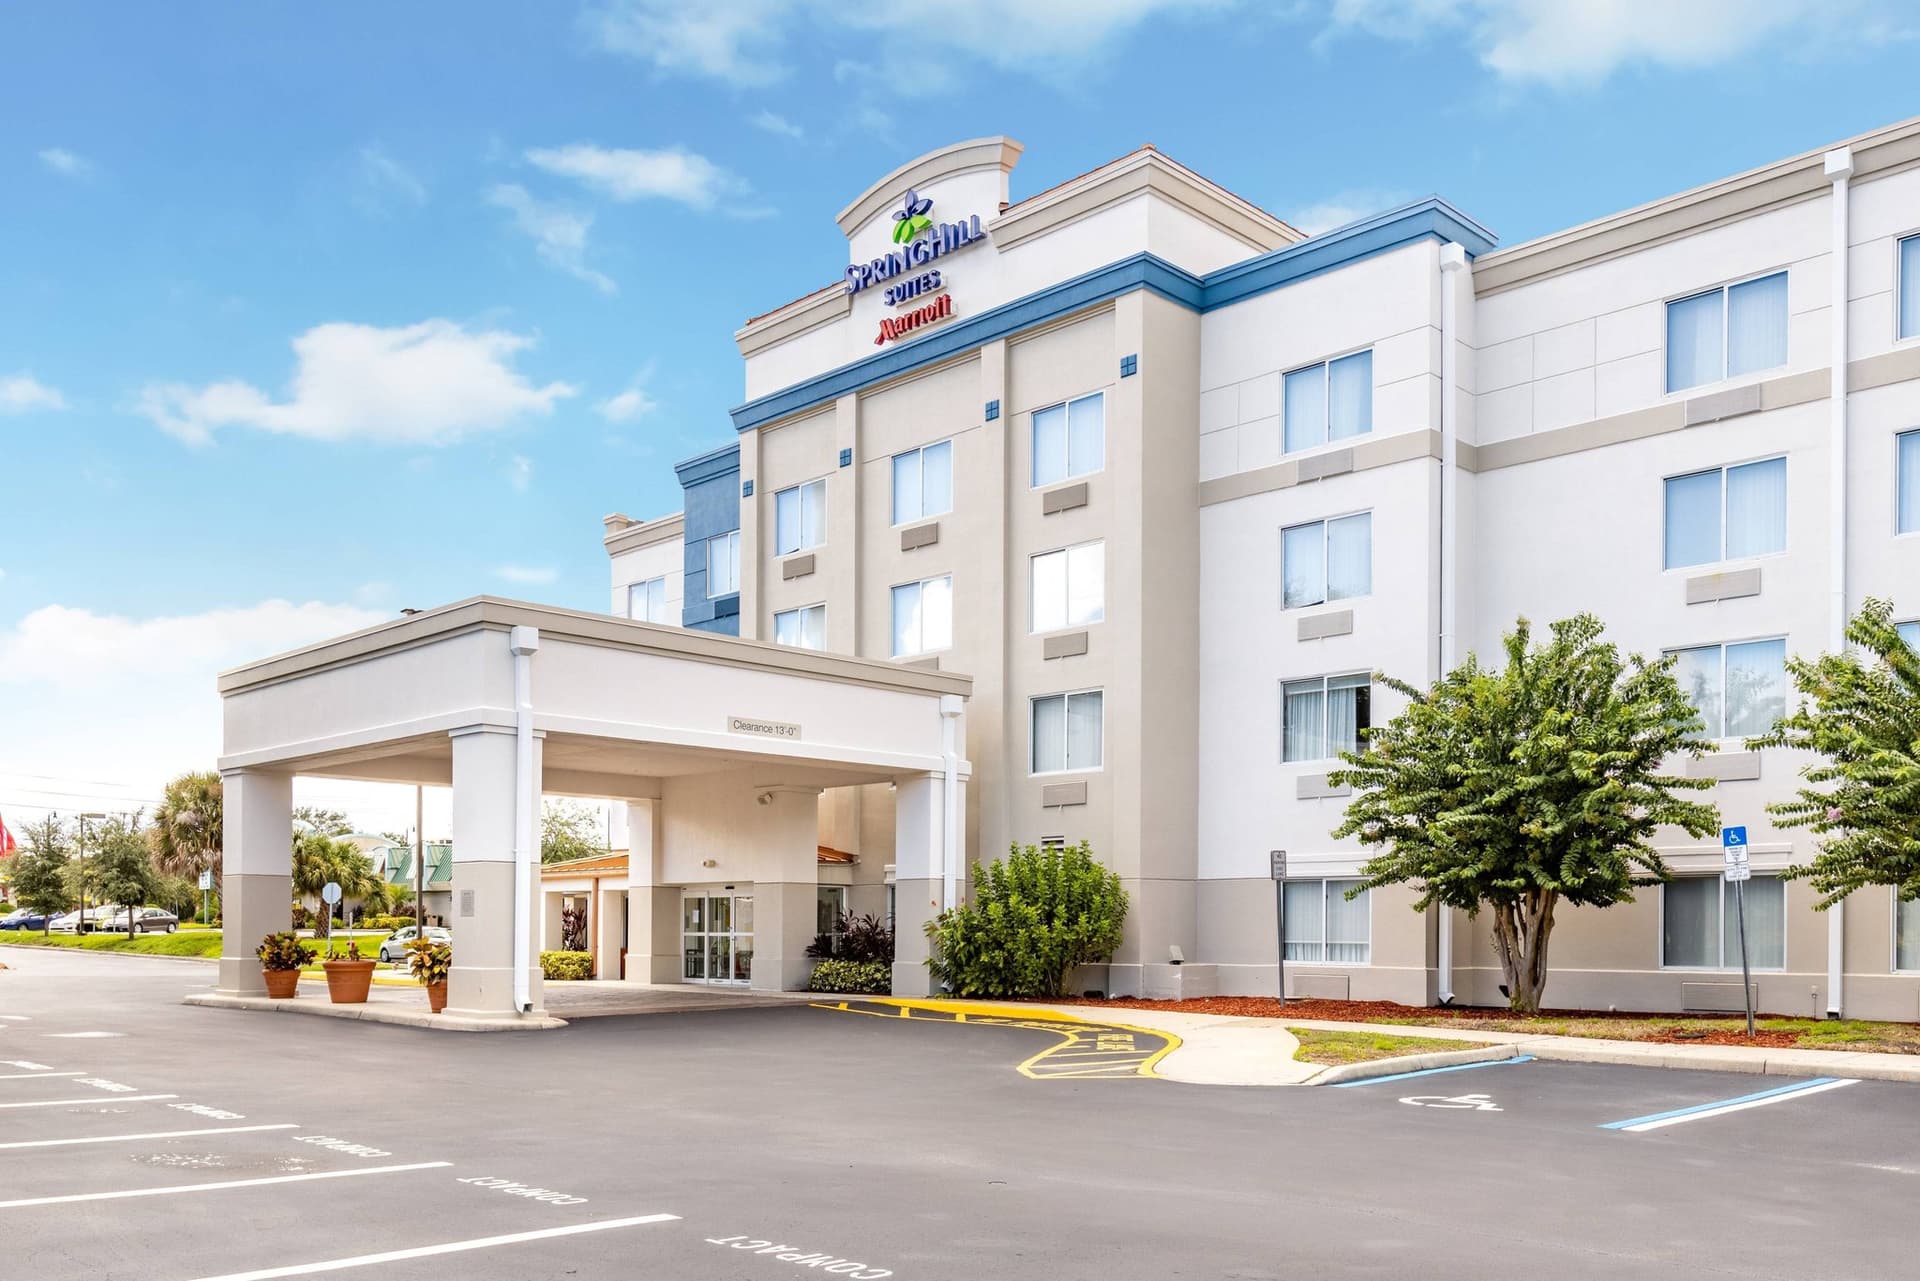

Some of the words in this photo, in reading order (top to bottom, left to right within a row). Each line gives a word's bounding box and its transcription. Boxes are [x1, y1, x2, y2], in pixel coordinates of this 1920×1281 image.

[844, 214, 987, 295] SPRINGHILL
[884, 270, 941, 305] SUITES
[874, 294, 951, 345] Marriott
[733, 719, 773, 733] Clearance
[455, 1176, 589, 1205] COMPACT
[704, 1235, 893, 1280] COMPACT
